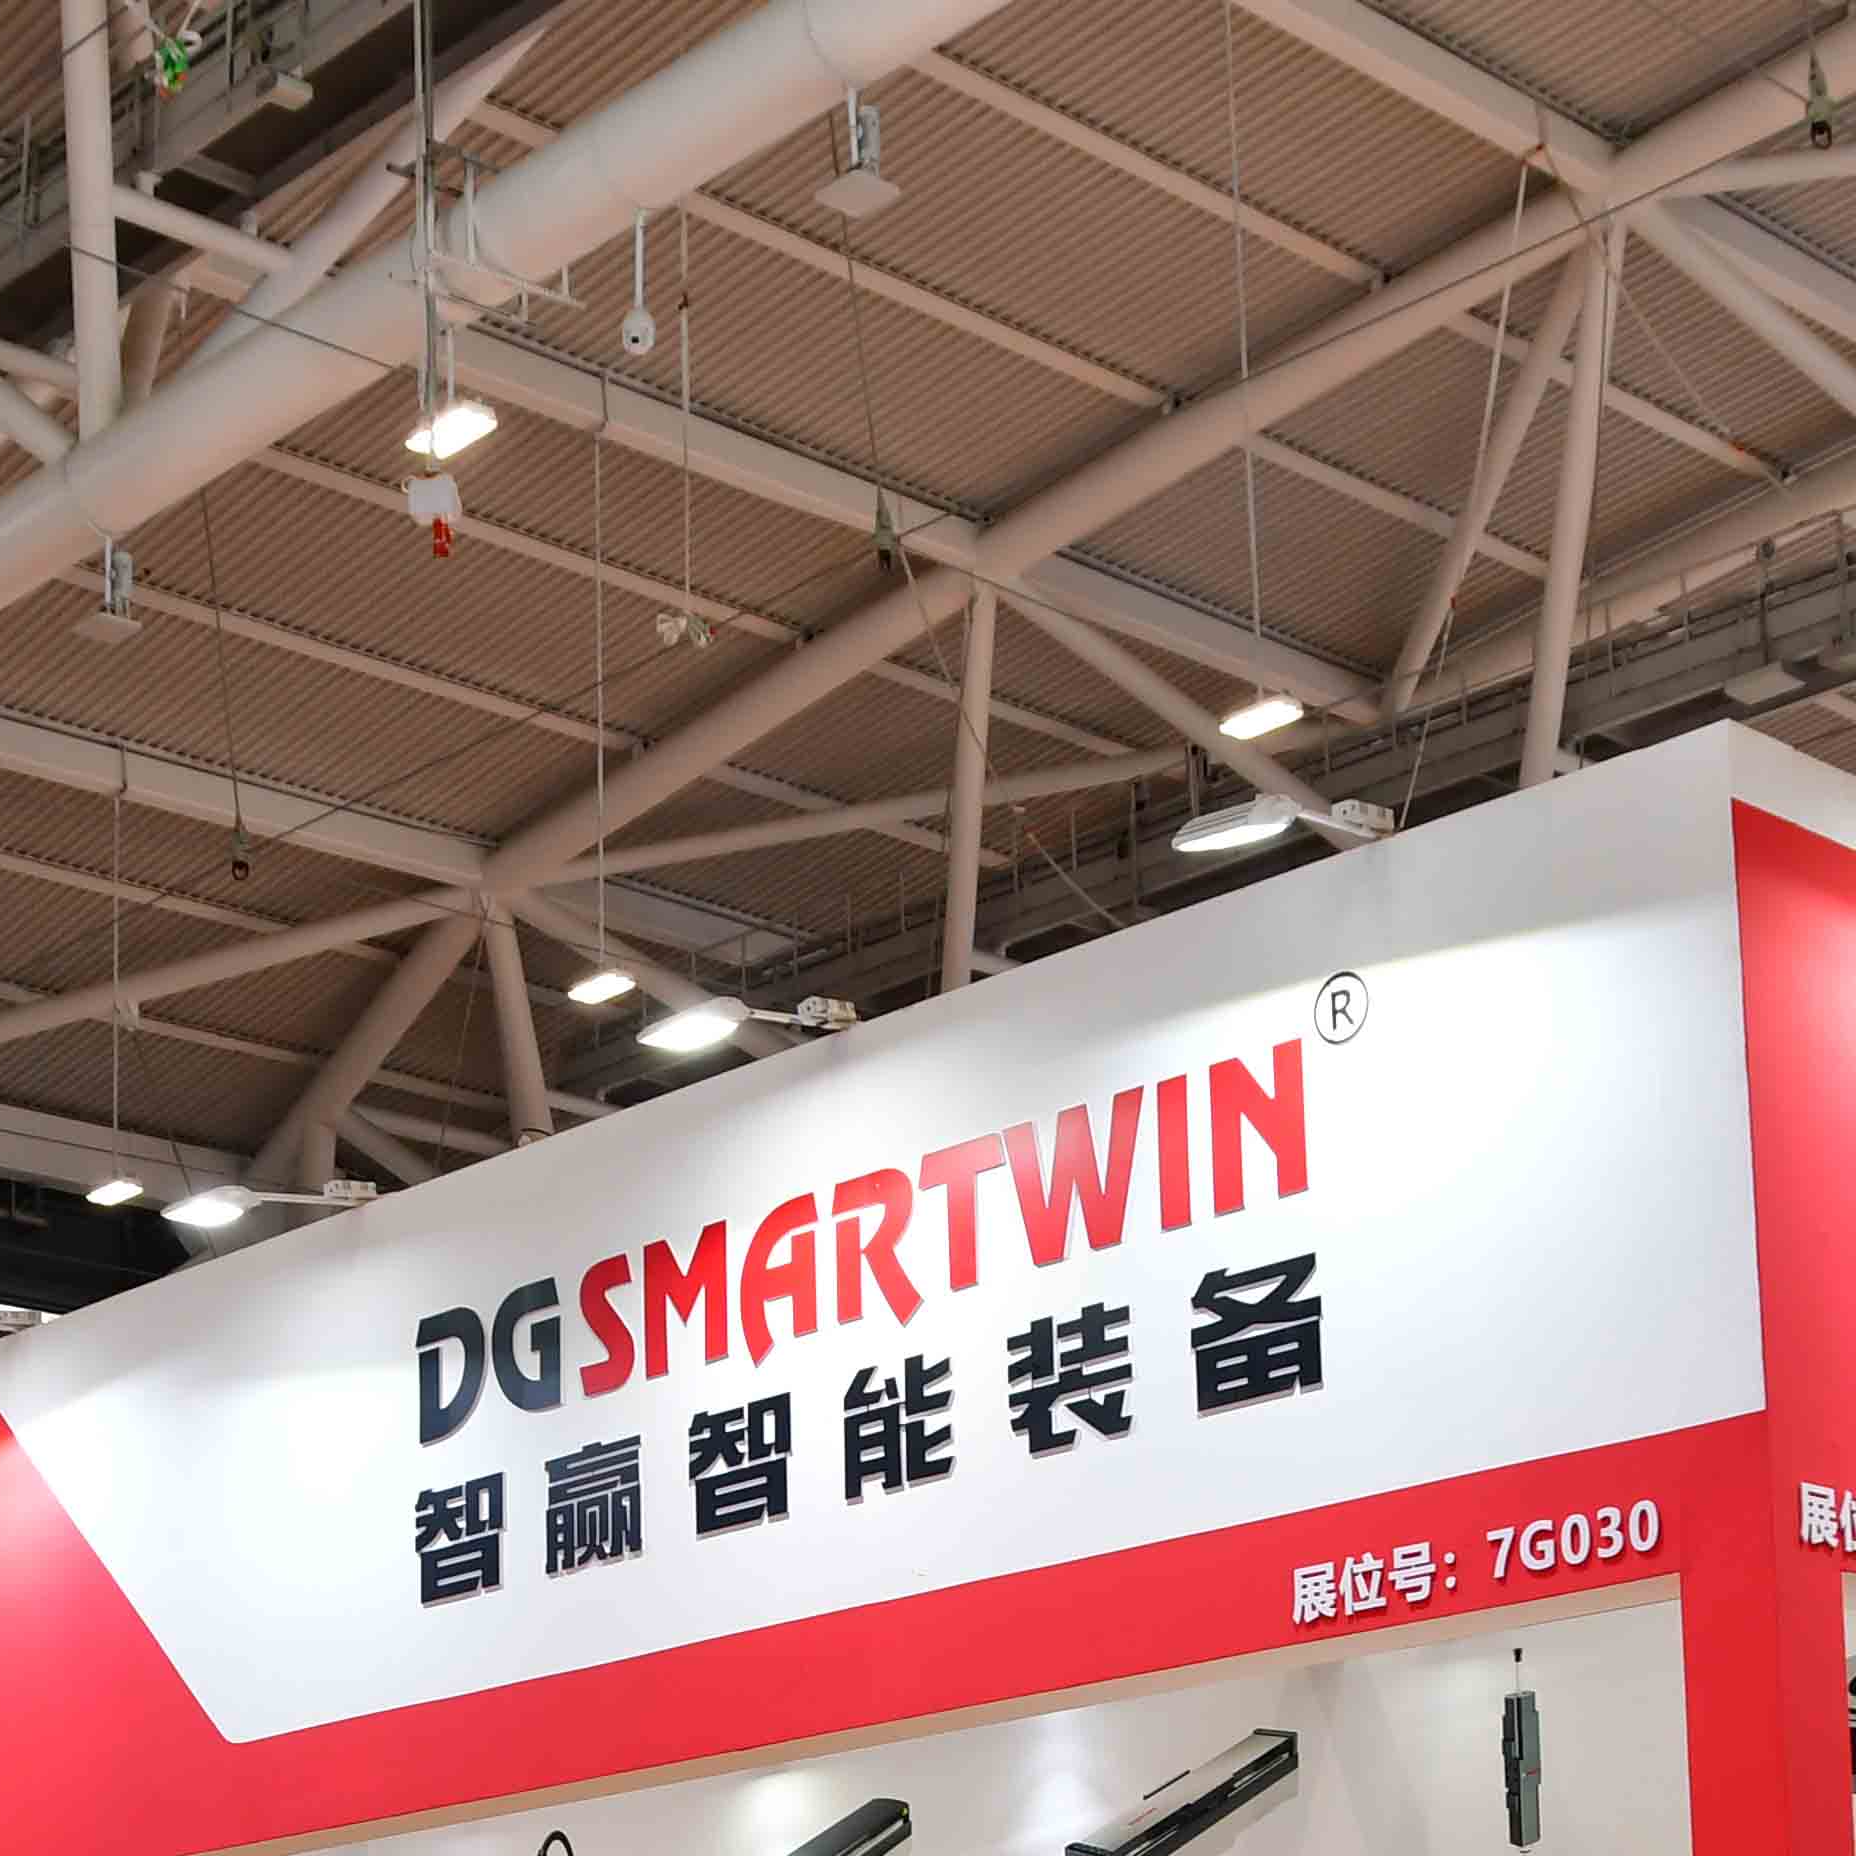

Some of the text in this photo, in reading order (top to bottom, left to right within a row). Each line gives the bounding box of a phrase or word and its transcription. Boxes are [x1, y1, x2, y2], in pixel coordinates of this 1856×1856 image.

[414, 1252, 1324, 1609] 智赢智能装备
[415, 1037, 1309, 1447] DGSMARTWIN
